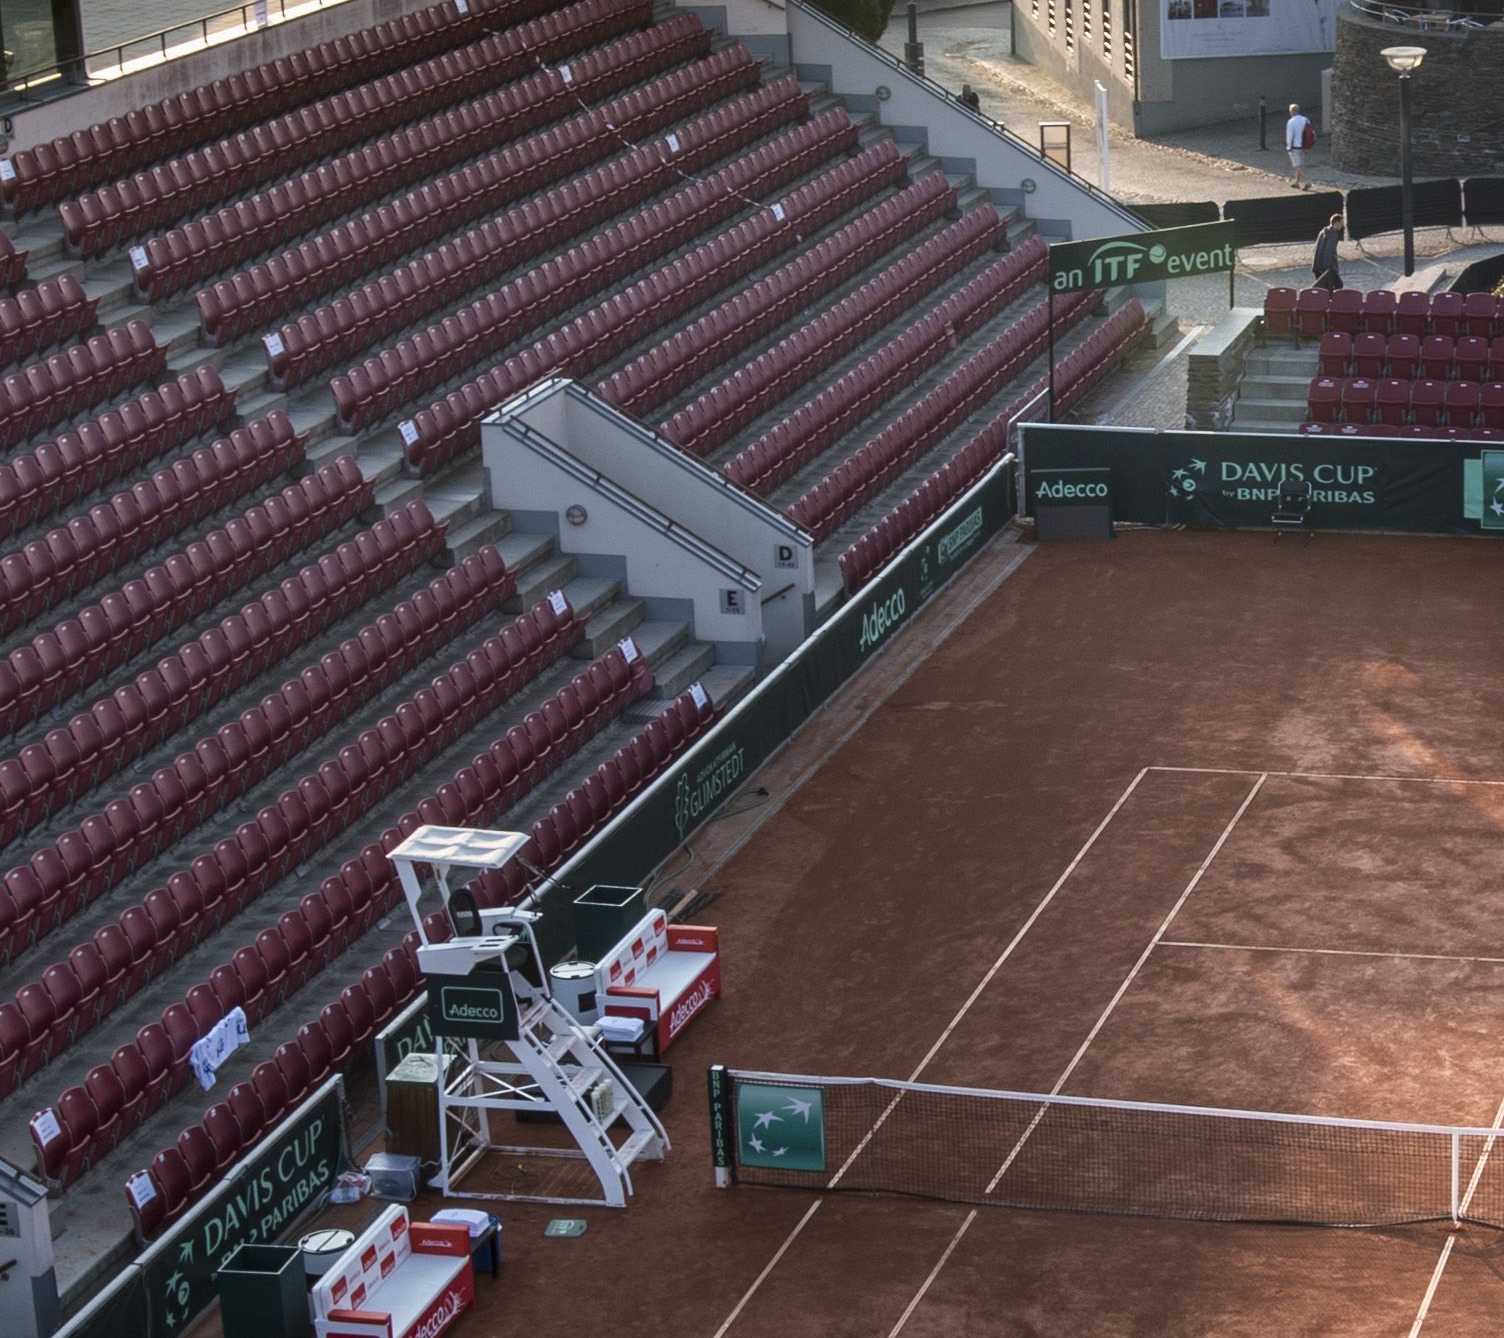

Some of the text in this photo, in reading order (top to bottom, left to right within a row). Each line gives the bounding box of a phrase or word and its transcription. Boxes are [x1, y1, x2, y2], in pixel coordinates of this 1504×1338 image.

[1054, 243, 1232, 290] an ITF event
[1035, 481, 1108, 499] Adecco
[1221, 462, 1374, 485] DAVIS CUP
[1237, 488, 1279, 502] BNP
[1283, 489, 1375, 504] RIBAS
[779, 546, 793, 561] D
[727, 590, 738, 606] E
[859, 588, 905, 652] Adecco
[690, 747, 745, 817] GLIMSTEDT
[449, 1004, 498, 1019] Adecco
[712, 1071, 725, 1166] BNP PARIBAS
[204, 1167, 274, 1257] DAVIS
[277, 1119, 323, 1183] CUP
[260, 1159, 330, 1239] PARIBAS
